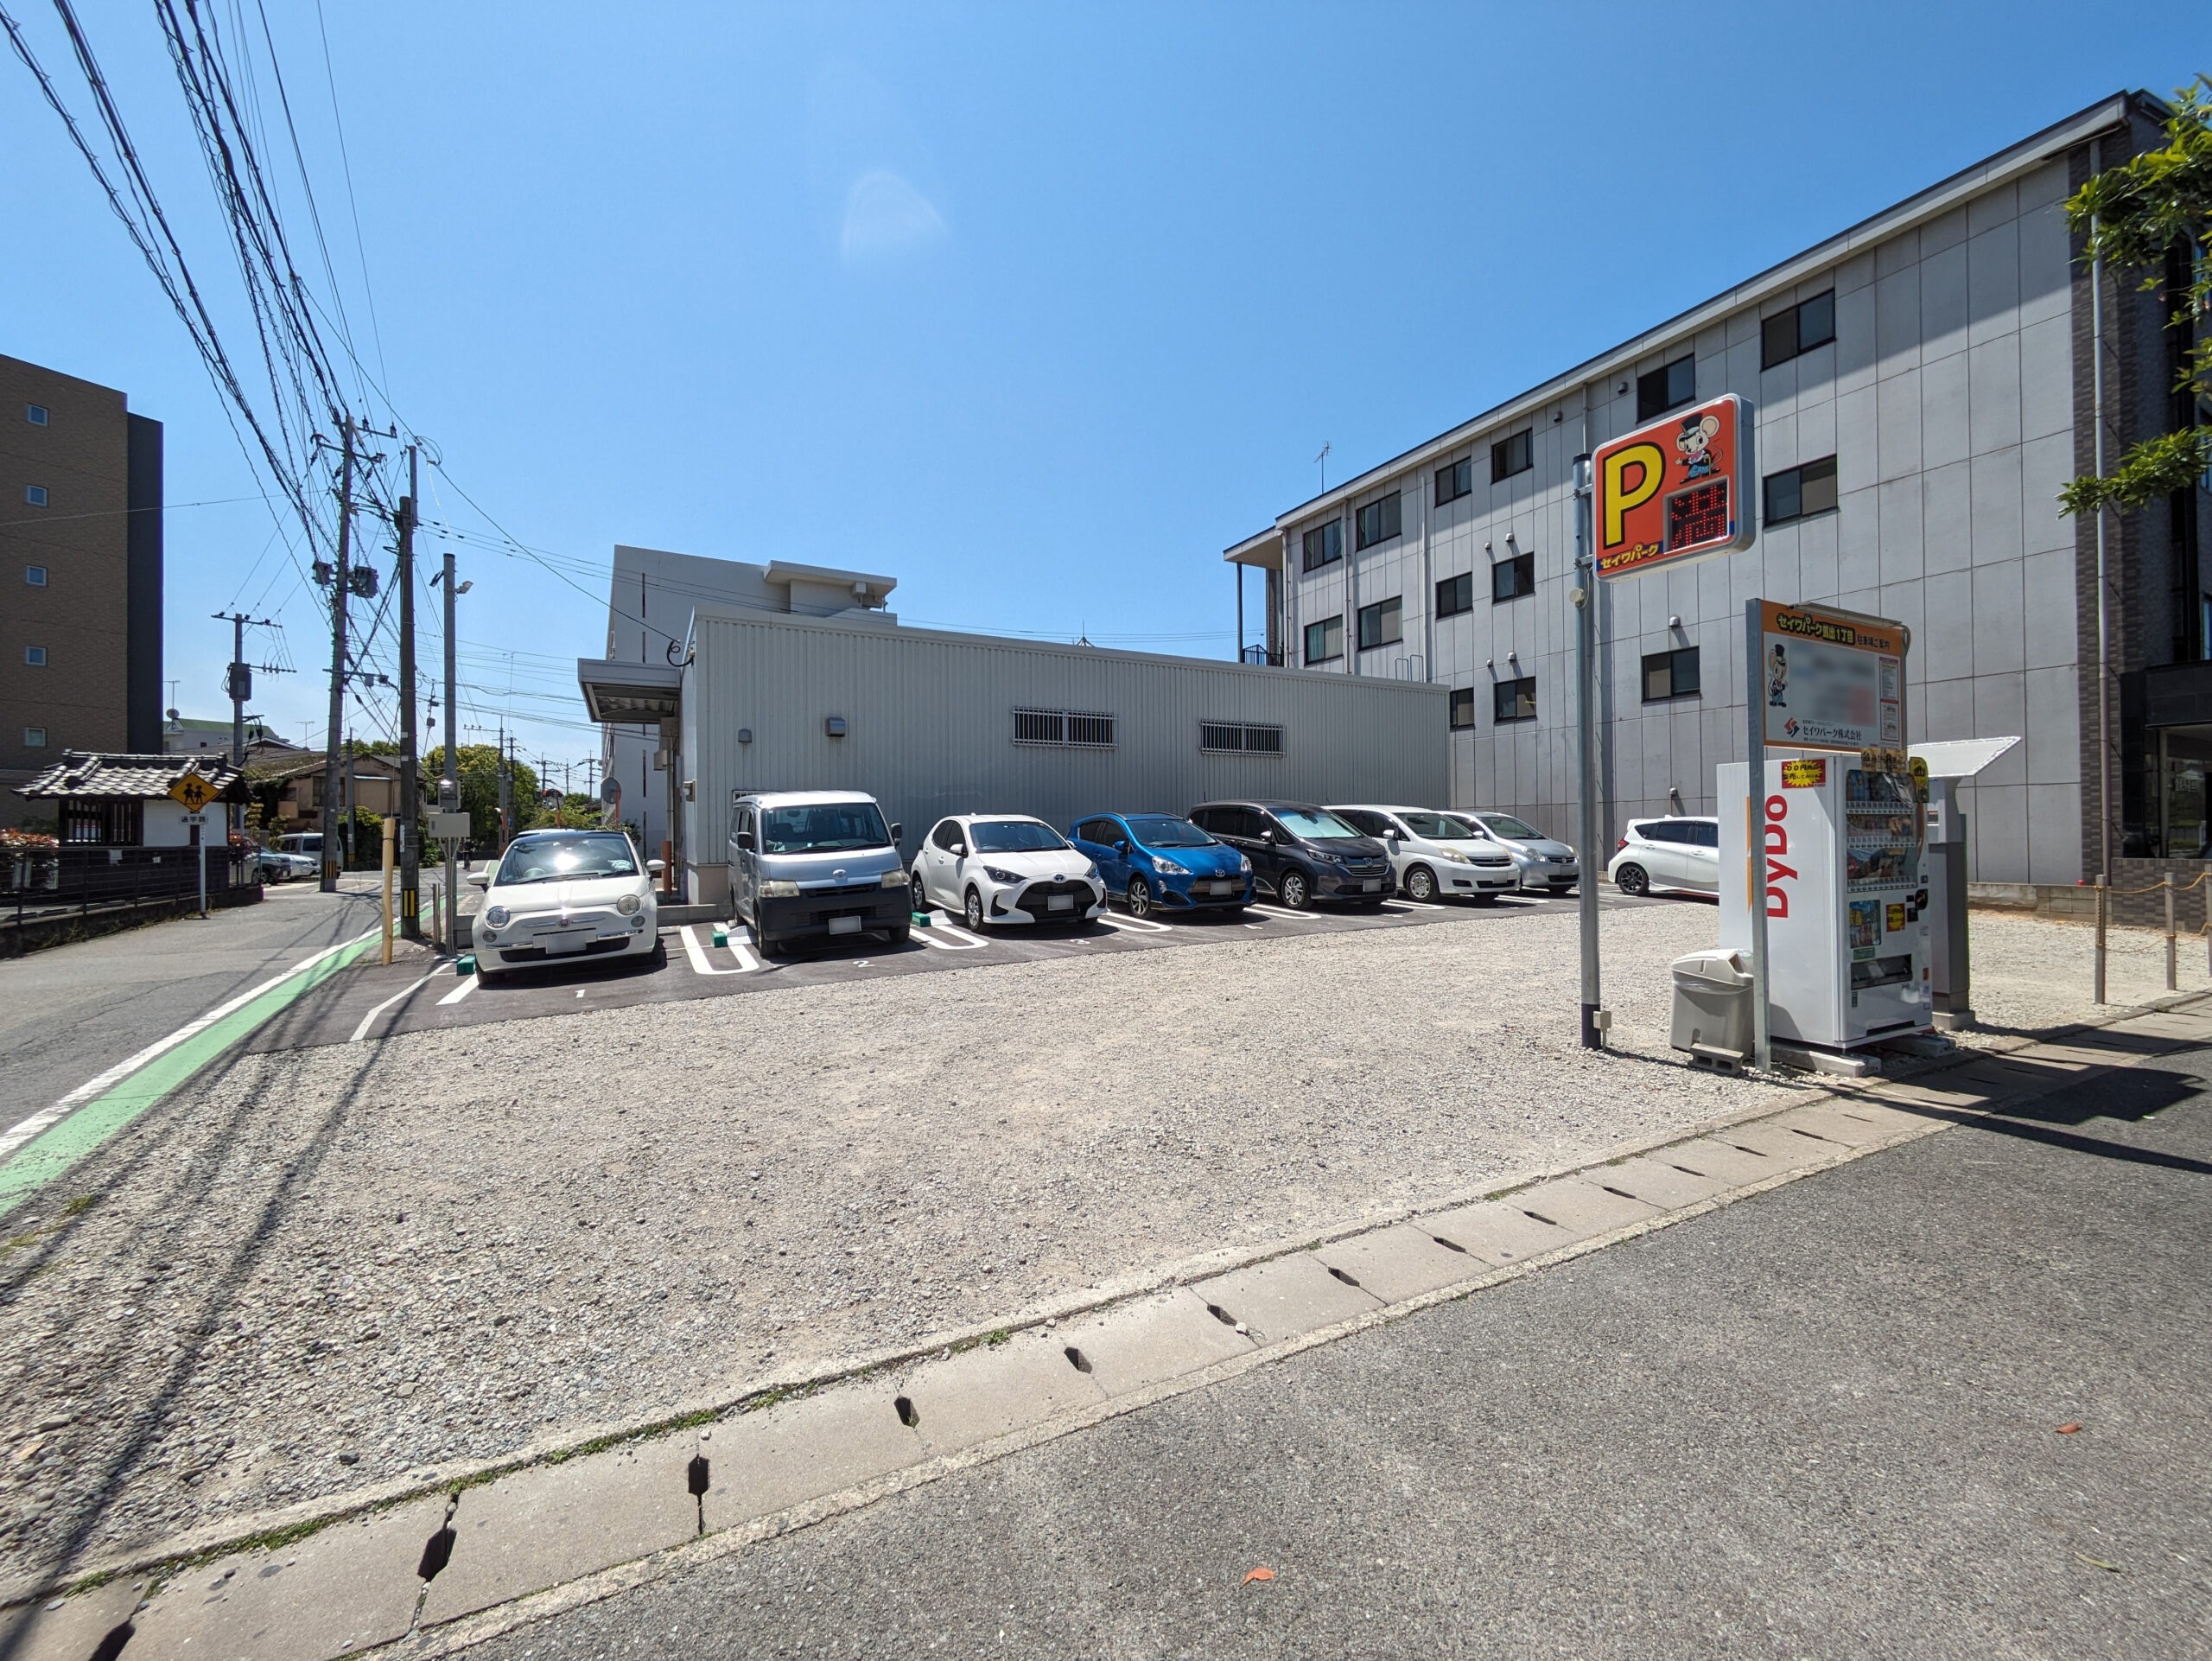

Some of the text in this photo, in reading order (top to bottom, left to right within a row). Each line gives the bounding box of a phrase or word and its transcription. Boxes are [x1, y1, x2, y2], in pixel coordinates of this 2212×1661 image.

[1603, 442, 1666, 550] P
[1671, 486, 1726, 550] 満
[1601, 542, 1660, 570] セイワパーク
[1802, 725, 1862, 741] セイワパーク株式会社
[1764, 794, 1798, 919] DyDo
[575, 989, 586, 998] 1
